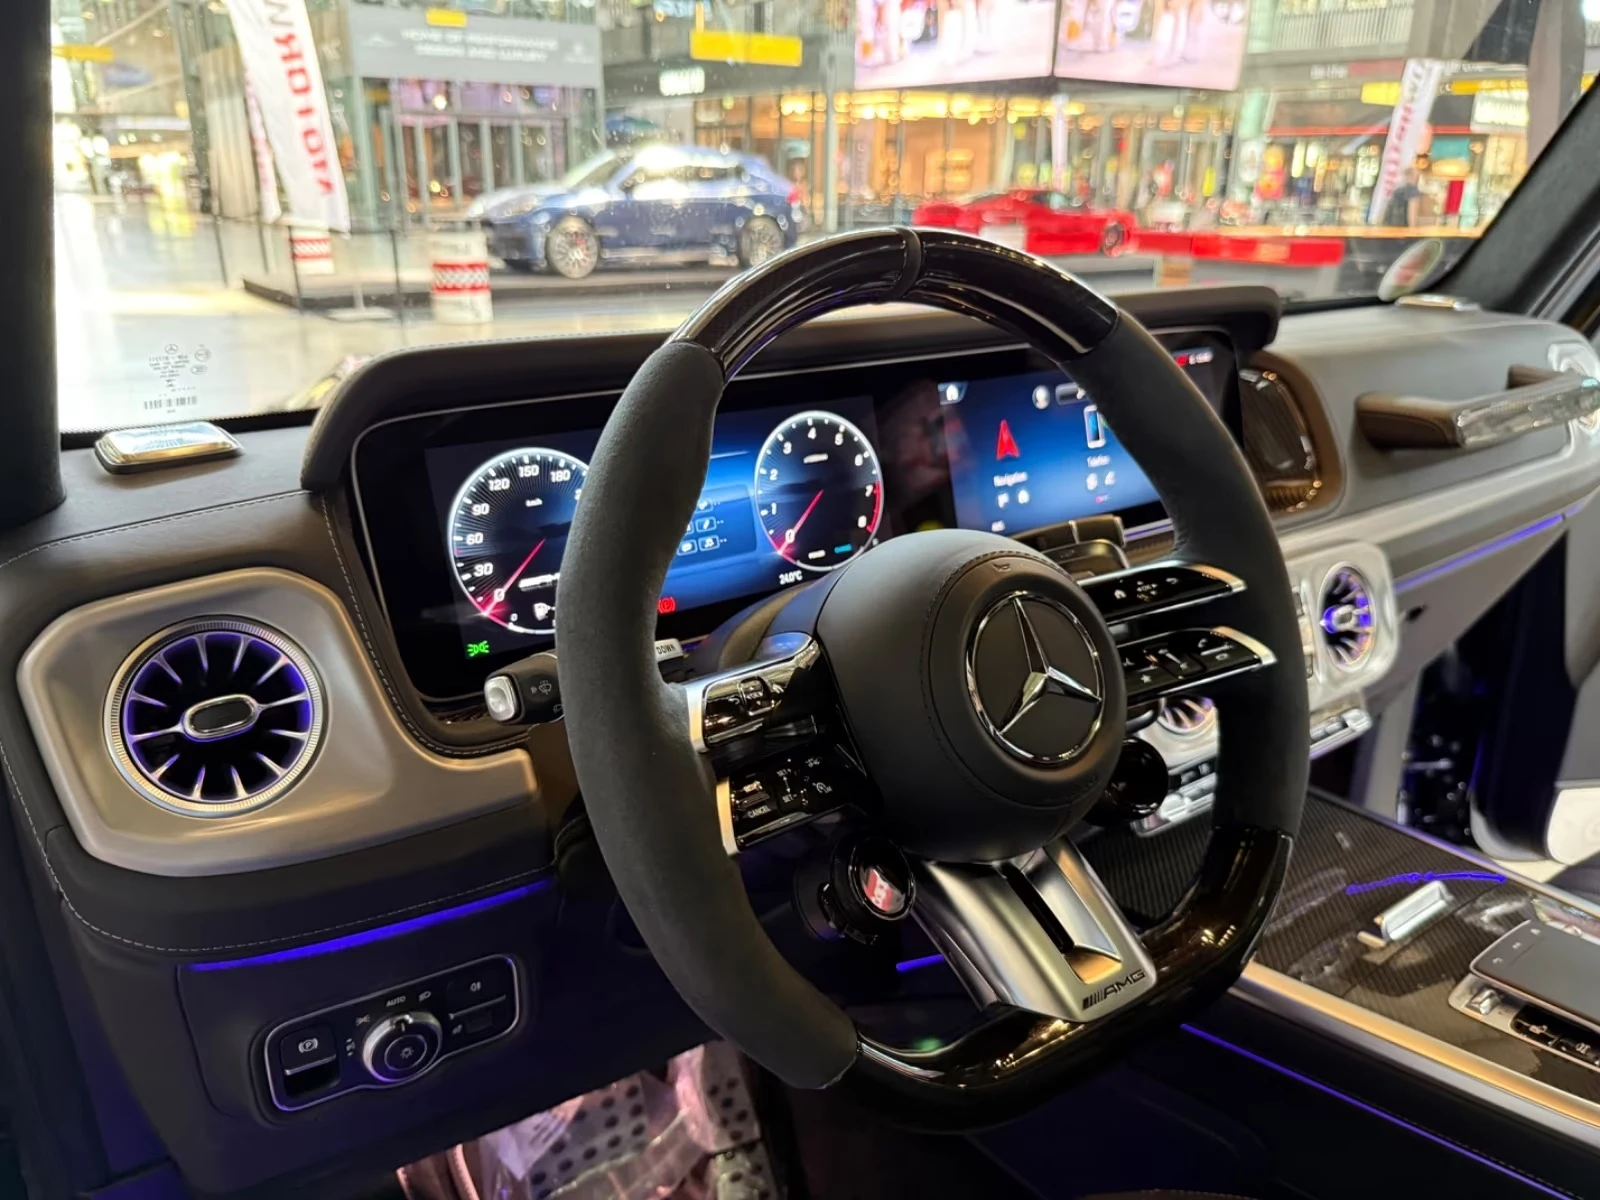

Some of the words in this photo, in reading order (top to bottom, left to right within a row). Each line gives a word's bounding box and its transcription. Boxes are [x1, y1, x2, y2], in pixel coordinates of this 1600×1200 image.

[807, 426, 817, 440] 4
[783, 441, 792, 455] 3
[518, 465, 540, 478] 150
[550, 470, 571, 483] 180
[769, 468, 779, 481] 2
[488, 478, 511, 491] 120
[865, 485, 875, 497] 7
[471, 503, 490, 516] 90
[465, 532, 484, 545] 60
[474, 563, 494, 577] 30
[656, 642, 676, 655] DOWN
[748, 806, 771, 818] CANCEL
[386, 995, 406, 1008] AUTO
